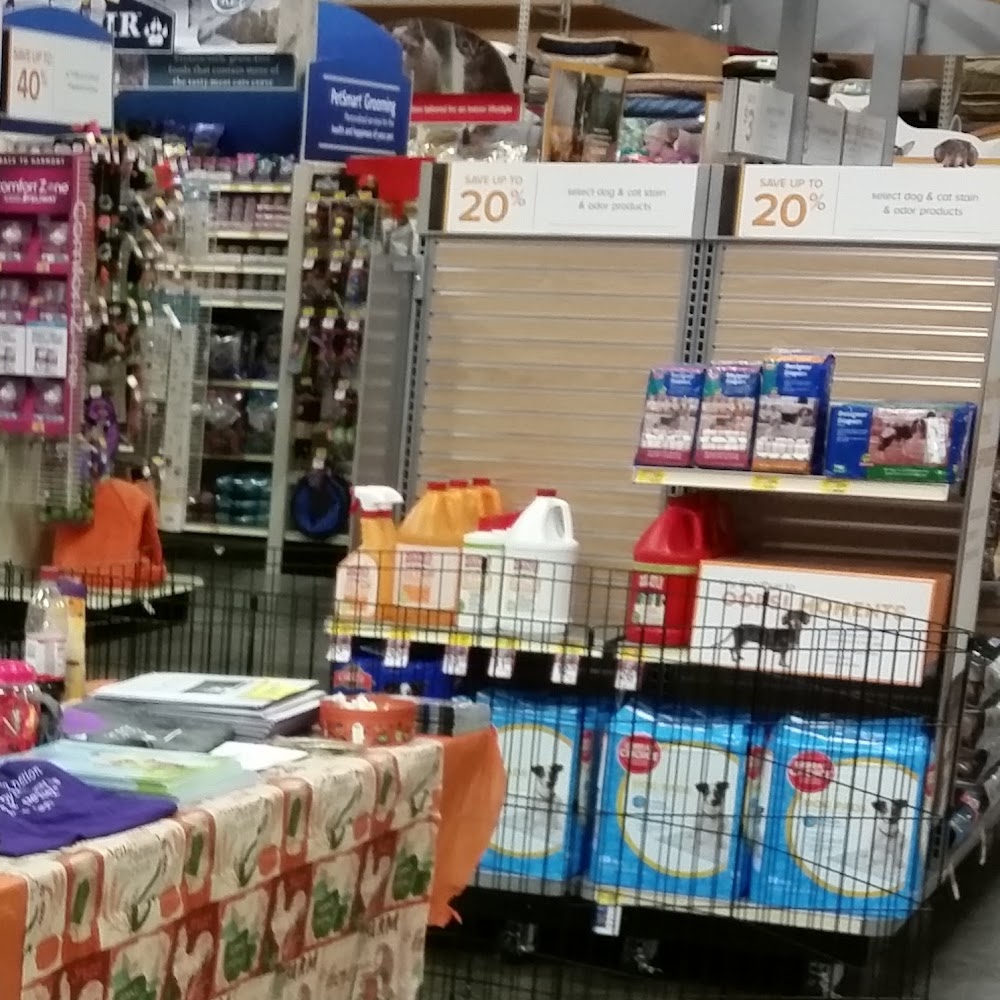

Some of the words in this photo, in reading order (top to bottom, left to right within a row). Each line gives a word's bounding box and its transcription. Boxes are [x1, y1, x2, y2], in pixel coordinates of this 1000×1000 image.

[331, 87, 362, 109] PetSmart
[364, 92, 397, 118] Grooming
[464, 175, 489, 185] SAVE
[493, 175, 507, 185] UP
[509, 175, 524, 185] TO
[759, 178, 786, 189] SAVE
[790, 178, 805, 188] UP
[809, 178, 824, 189] TO
[568, 187, 595, 198] select
[596, 187, 616, 199] dog
[617, 188, 624, 197] &
[627, 188, 643, 198] cat
[644, 187, 667, 198] stain
[871, 190, 901, 201] select
[903, 191, 924, 203] dog
[926, 192, 934, 202] &
[936, 192, 953, 202] cat
[955, 192, 979, 203] stain
[578, 201, 586, 211] &
[587, 201, 610, 211] odor
[611, 202, 652, 213] products
[883, 206, 890, 215] &
[893, 205, 917, 216] odor
[918, 206, 964, 218] products
